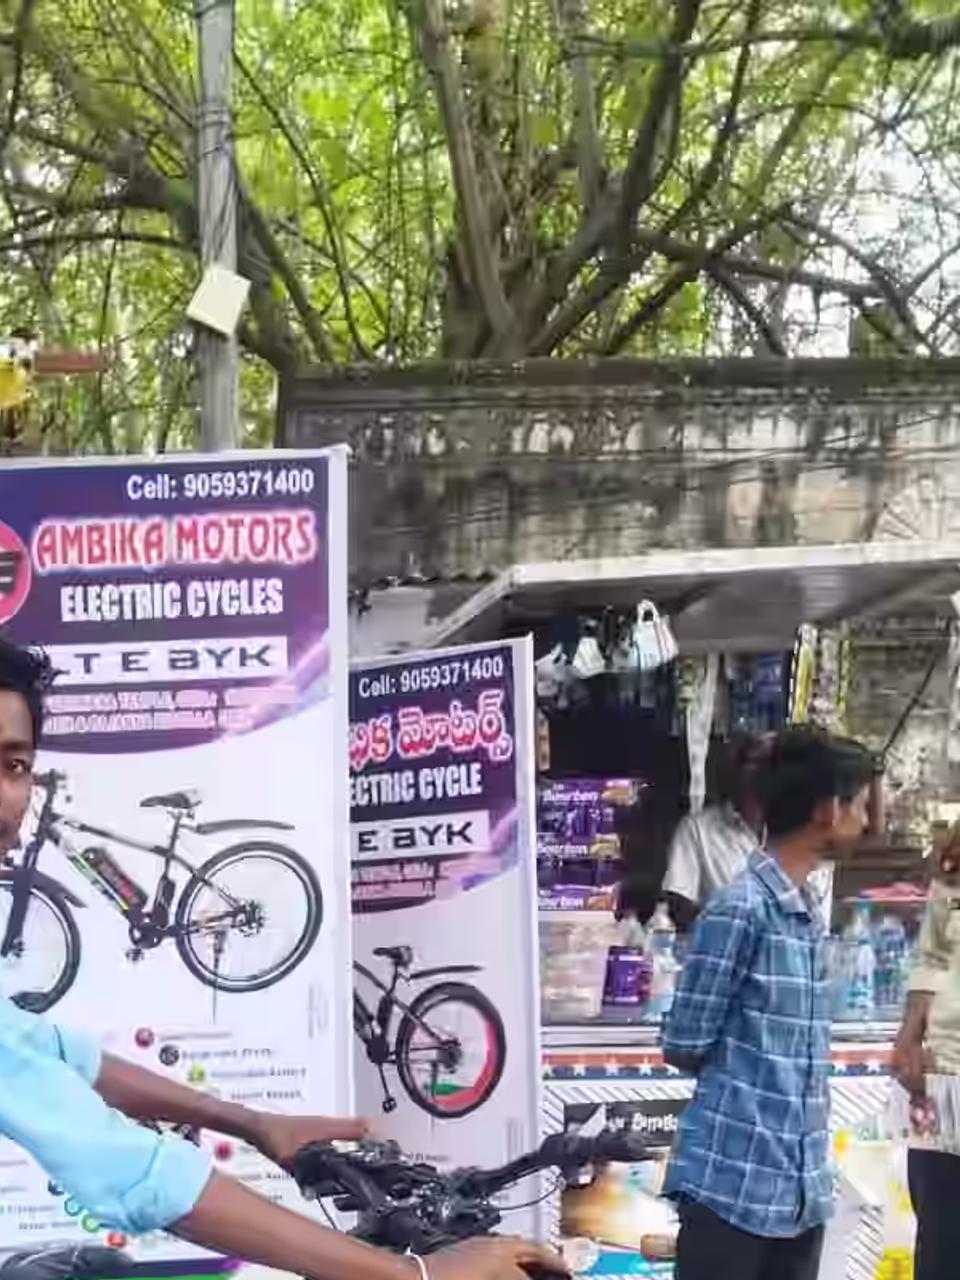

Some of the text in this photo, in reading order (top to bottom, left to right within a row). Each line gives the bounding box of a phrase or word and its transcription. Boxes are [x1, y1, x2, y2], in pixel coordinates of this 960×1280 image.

[127, 469, 316, 500] Cell: 9059371400
[33, 509, 318, 574] AMBIKA MOTORS
[60, 577, 284, 622] ELECTRIC CYCLES
[358, 656, 504, 698] Cell: 9059371400
[419, 763, 482, 801] CYCLE
